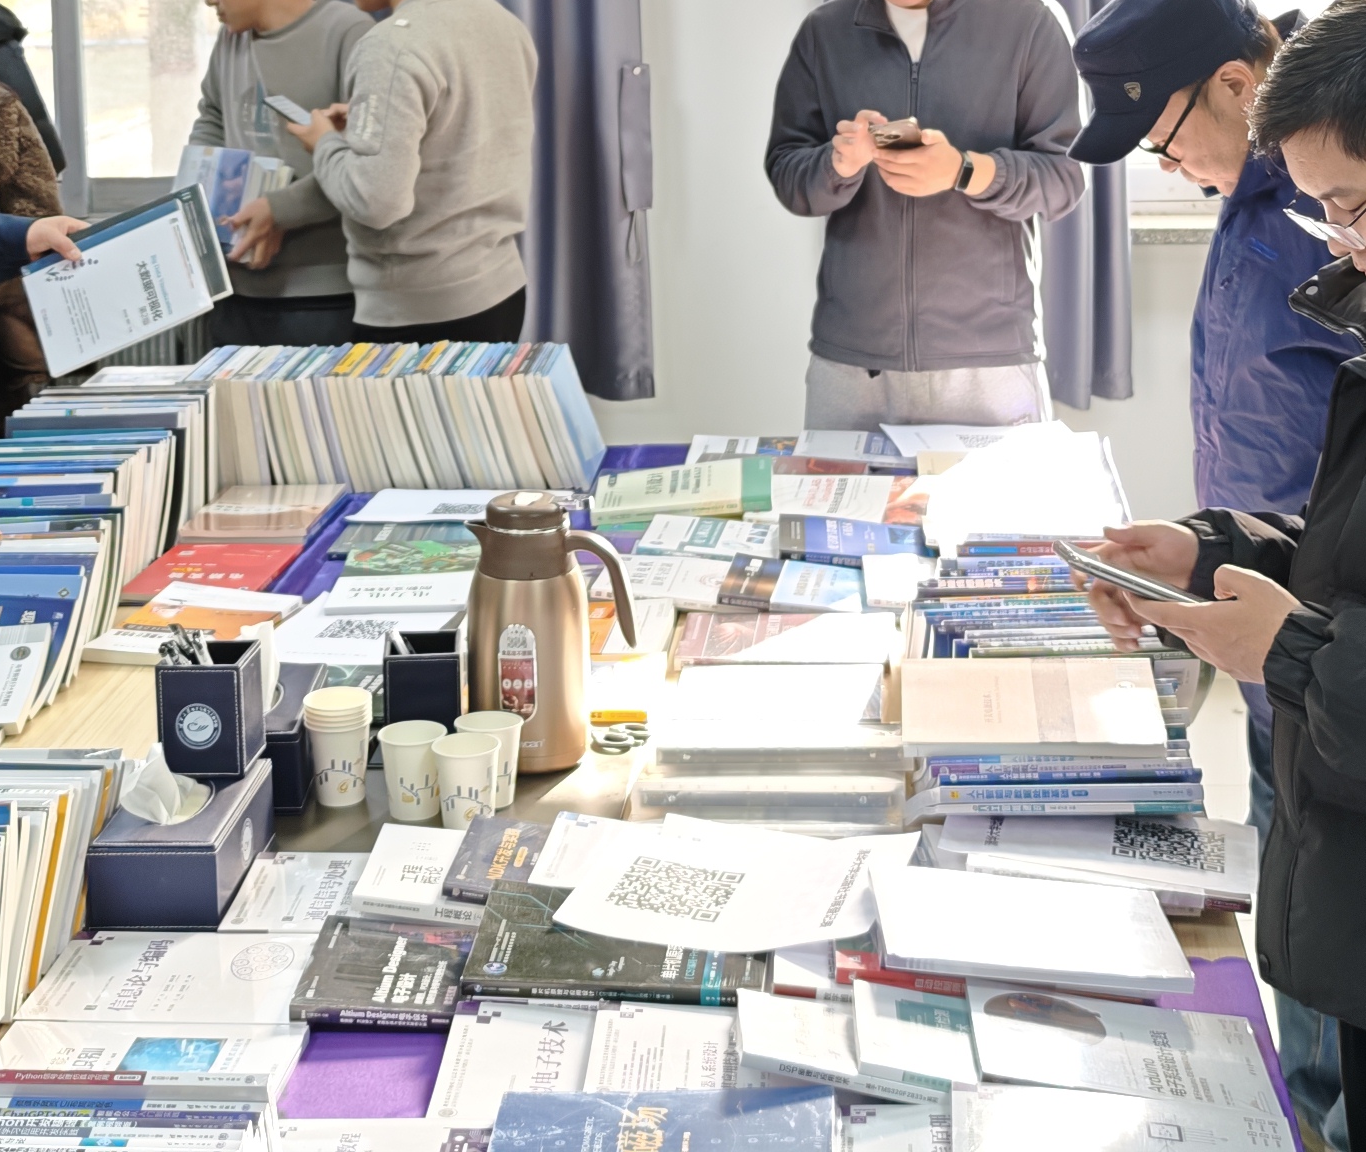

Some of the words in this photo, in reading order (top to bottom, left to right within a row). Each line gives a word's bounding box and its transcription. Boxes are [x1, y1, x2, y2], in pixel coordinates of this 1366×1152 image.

[136, 260, 165, 321] 大数据可视化
[303, 859, 353, 921] 通信信号处理
[107, 939, 176, 1012] 信息论与编码
[1142, 1057, 1163, 1095] Arduino
